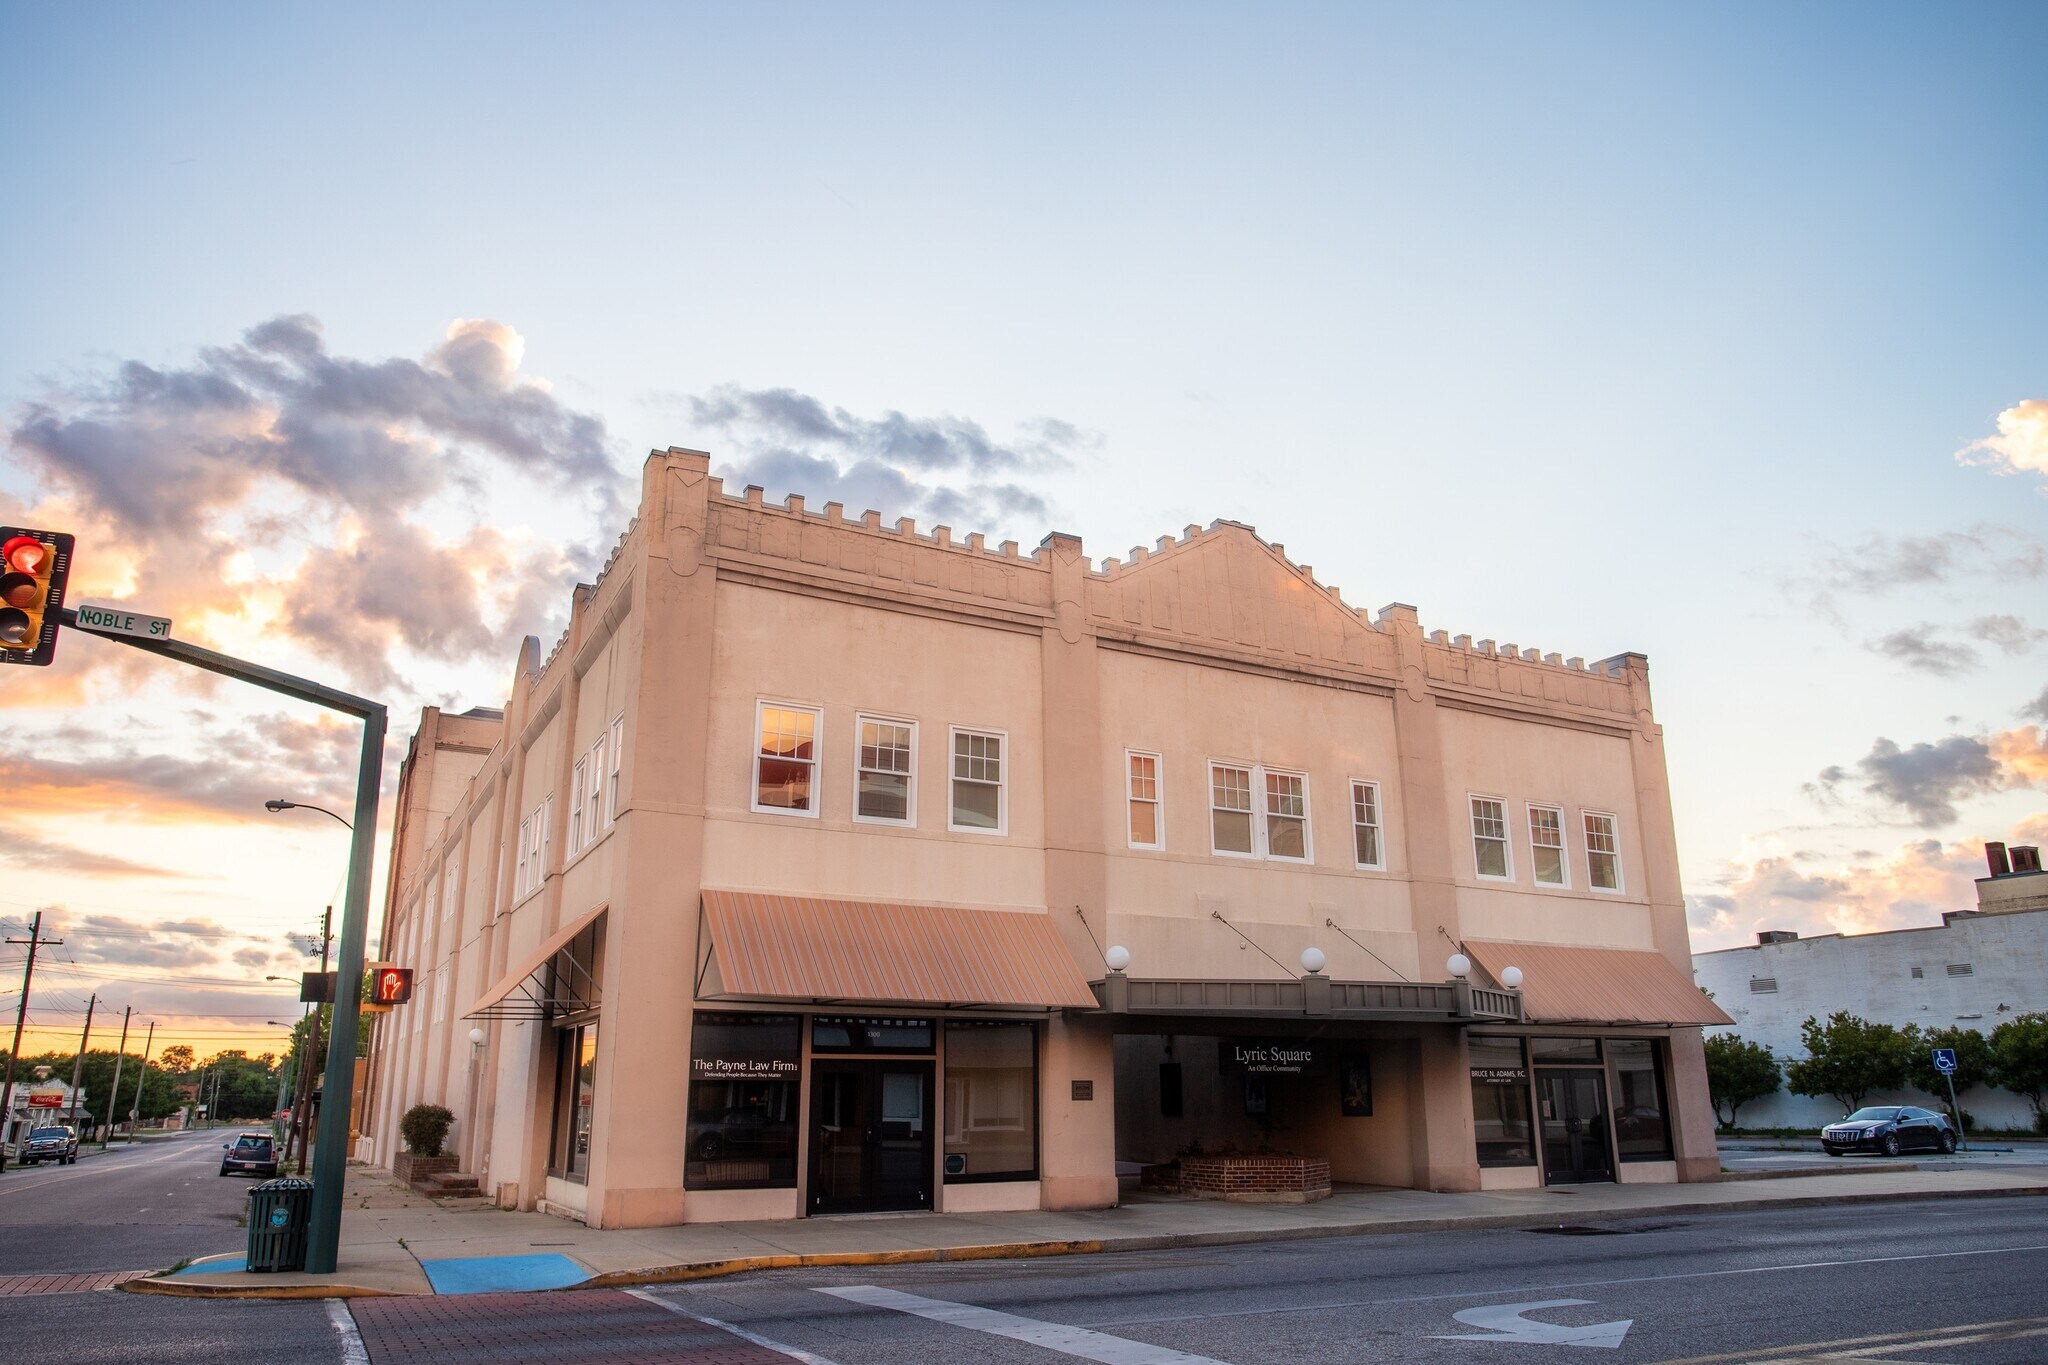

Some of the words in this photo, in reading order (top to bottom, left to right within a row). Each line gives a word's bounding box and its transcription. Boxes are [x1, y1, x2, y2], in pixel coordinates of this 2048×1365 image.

[79, 609, 135, 631] NOBLE
[149, 620, 170, 636] ST
[1235, 1046, 1267, 1065] Lyric
[1270, 1046, 1312, 1065] Square
[693, 1058, 713, 1070] The
[716, 1059, 746, 1073] Payne
[749, 1060, 770, 1071] Law
[772, 1060, 794, 1071] Firm
[1272, 1065, 1301, 1074] Community
[1471, 1070, 1488, 1078] BRUCE
